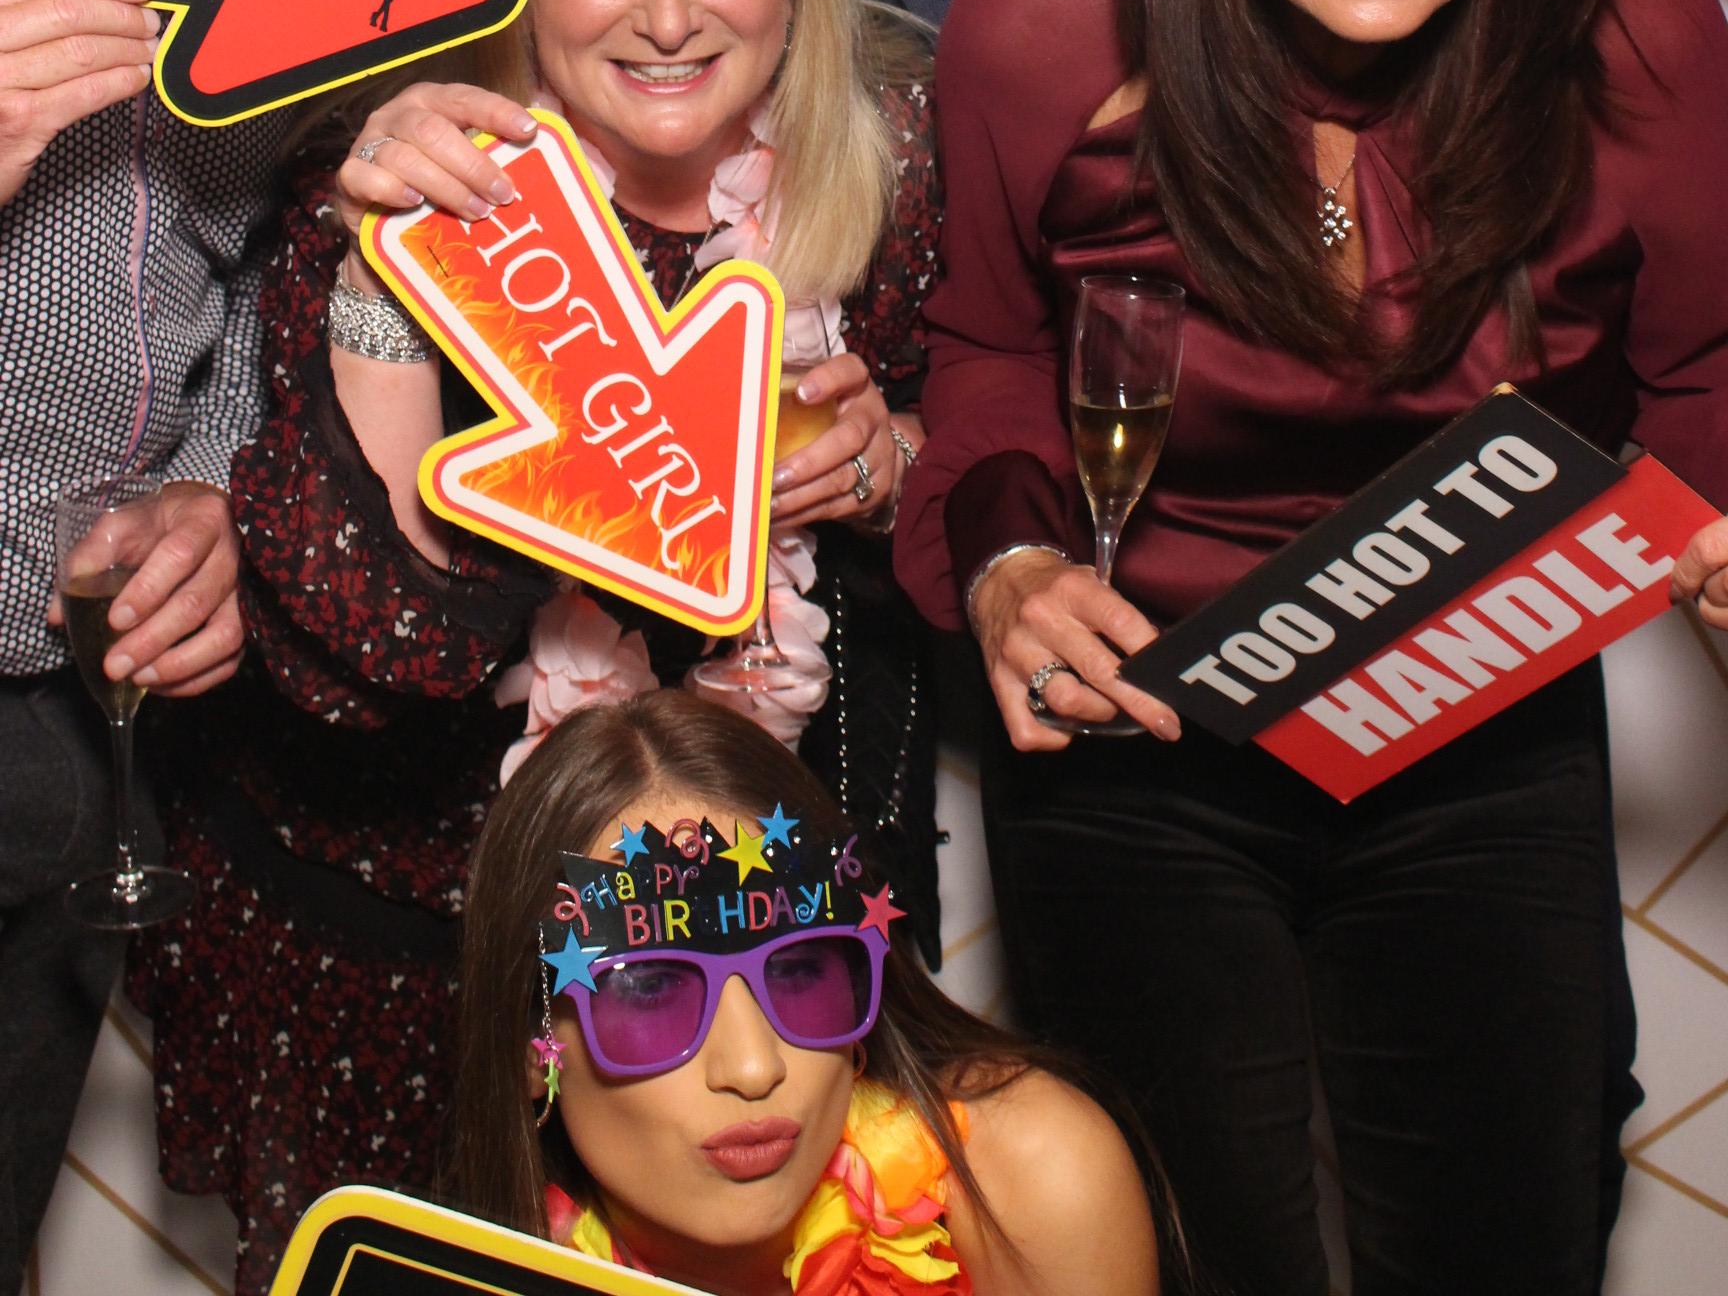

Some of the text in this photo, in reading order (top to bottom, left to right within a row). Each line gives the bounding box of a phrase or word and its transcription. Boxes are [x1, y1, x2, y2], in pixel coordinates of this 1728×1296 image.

[459, 188, 726, 570] HOT GIRL
[1179, 435, 1558, 706] TOO HOT TO
[1300, 512, 1676, 757] HANDLE
